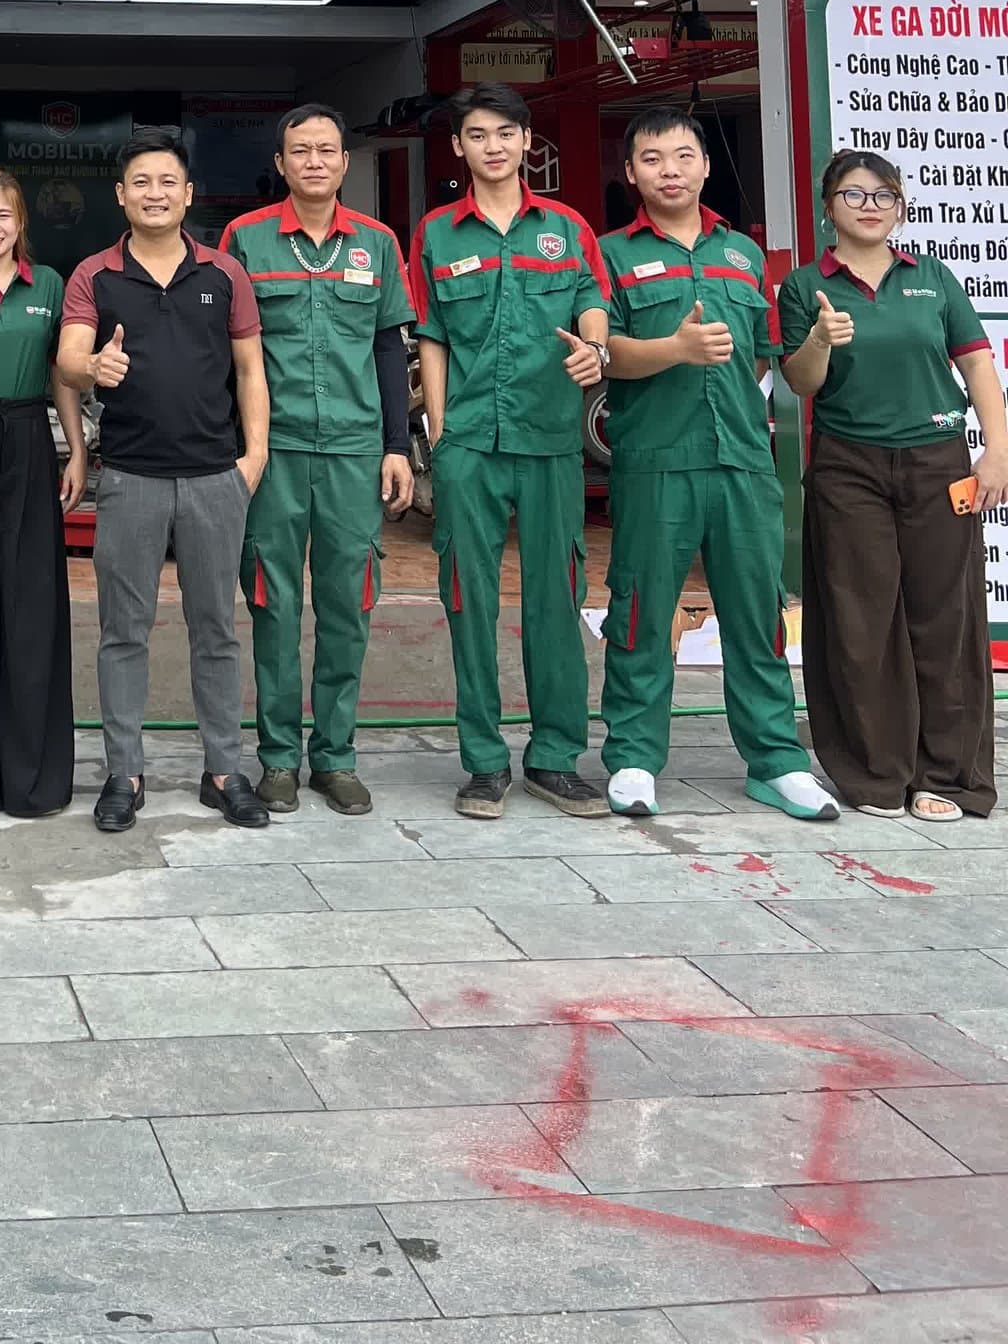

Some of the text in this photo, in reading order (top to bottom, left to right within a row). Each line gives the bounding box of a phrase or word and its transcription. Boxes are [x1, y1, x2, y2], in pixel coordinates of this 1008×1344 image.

[852, 6, 883, 36] XE
[891, 6, 924, 37] GA
[930, 0, 971, 38] ĐỜI
[847, 53, 890, 77] Công
[896, 55, 941, 80] Nghệ
[947, 55, 979, 76] Cao
[849, 88, 882, 112] Sửa
[888, 90, 931, 113] Chữa
[938, 92, 950, 113] &
[956, 88, 989, 113] Bảo
[7, 142, 113, 160] MOBILITY
[850, 128, 891, 151] Thay
[897, 128, 929, 151] Dây
[934, 129, 985, 150] Curoa
[919, 164, 947, 186] Cài
[953, 164, 982, 191] Đặt
[907, 197, 933, 223] ểm
[938, 202, 966, 224] Tra
[972, 199, 994, 224] Xử
[543, 239, 562, 252] HC
[927, 236, 980, 263] Buồng
[964, 273, 1008, 297] Giảm
